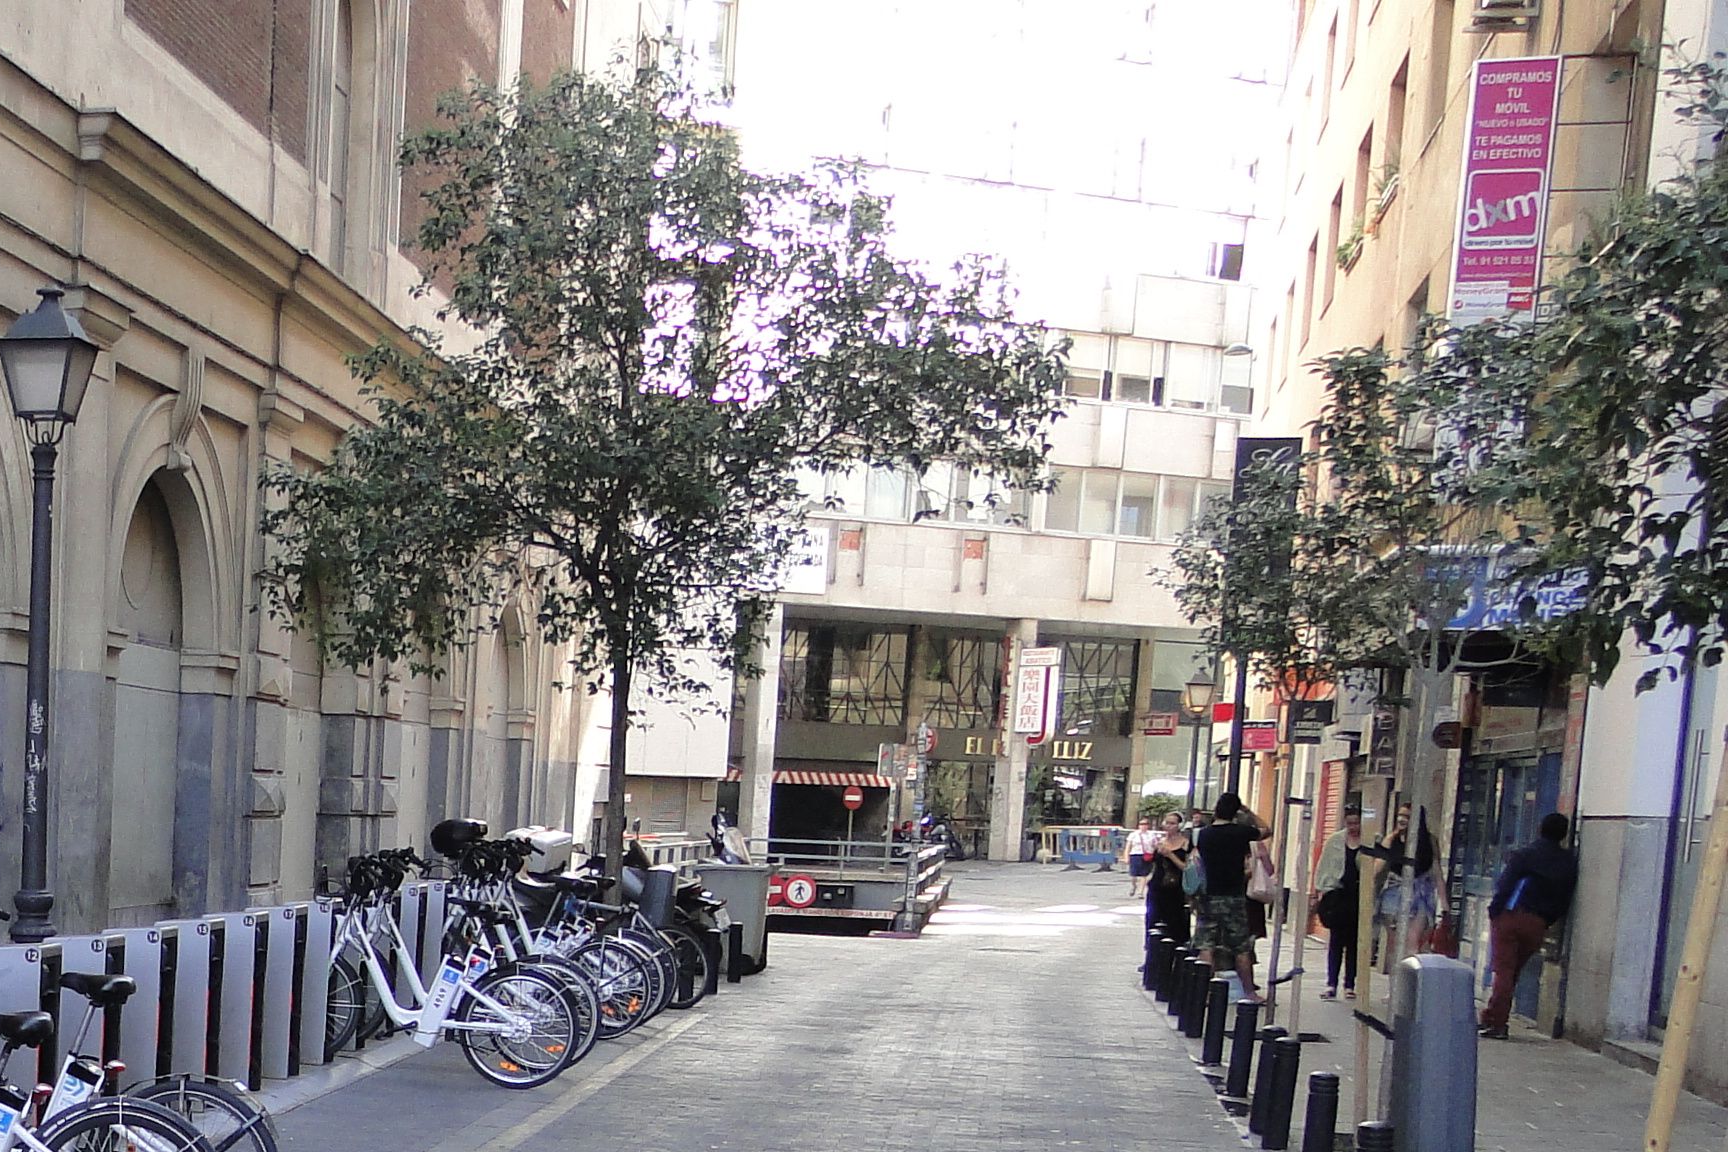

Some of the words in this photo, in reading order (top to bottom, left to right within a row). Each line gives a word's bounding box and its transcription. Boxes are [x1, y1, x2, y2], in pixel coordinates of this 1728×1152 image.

[1479, 71, 1552, 85] COMPRAMOS
[1507, 87, 1522, 98] TU
[1475, 136, 1488, 146] TE
[1490, 134, 1542, 145] PAGAMOS
[1472, 149, 1487, 160] EN
[1489, 148, 1541, 159] EFECTIVO
[244, 916, 254, 926] 16
[197, 924, 207, 934] 15
[147, 931, 158, 942] 14
[92, 940, 103, 950] 13
[27, 949, 38, 960] 12
